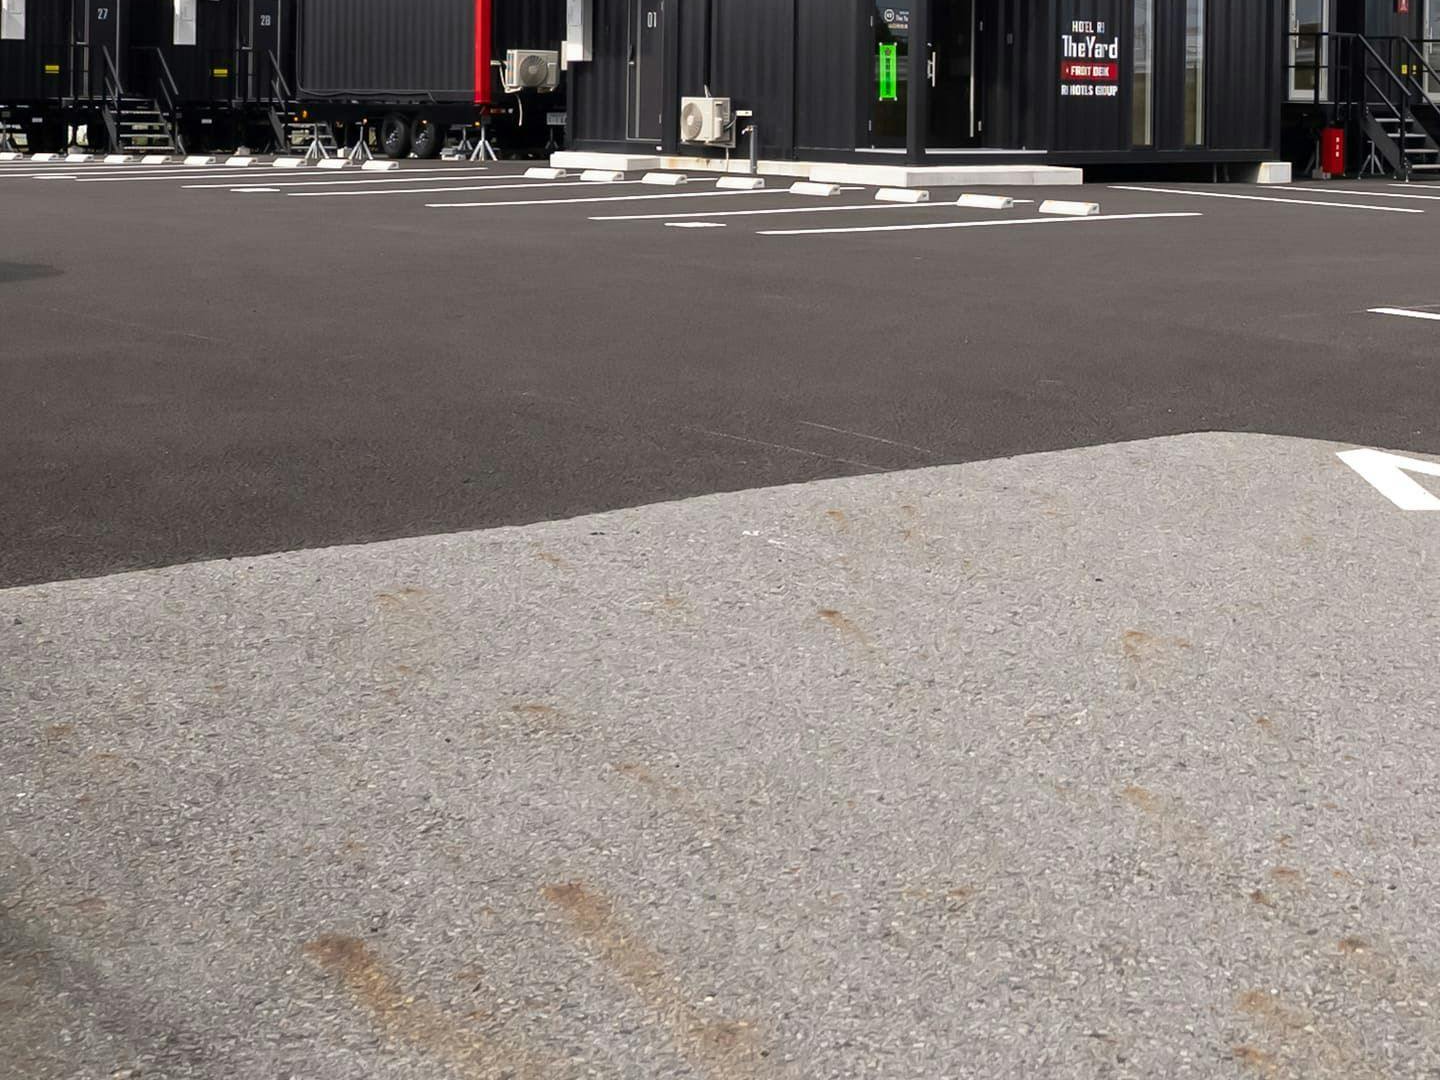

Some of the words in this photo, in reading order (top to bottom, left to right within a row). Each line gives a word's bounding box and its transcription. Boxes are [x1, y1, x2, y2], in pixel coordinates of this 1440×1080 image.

[97, 8, 108, 20] 27
[647, 11, 657, 28] 01
[1061, 35, 1086, 58] The
[1086, 35, 1119, 59] Yard
